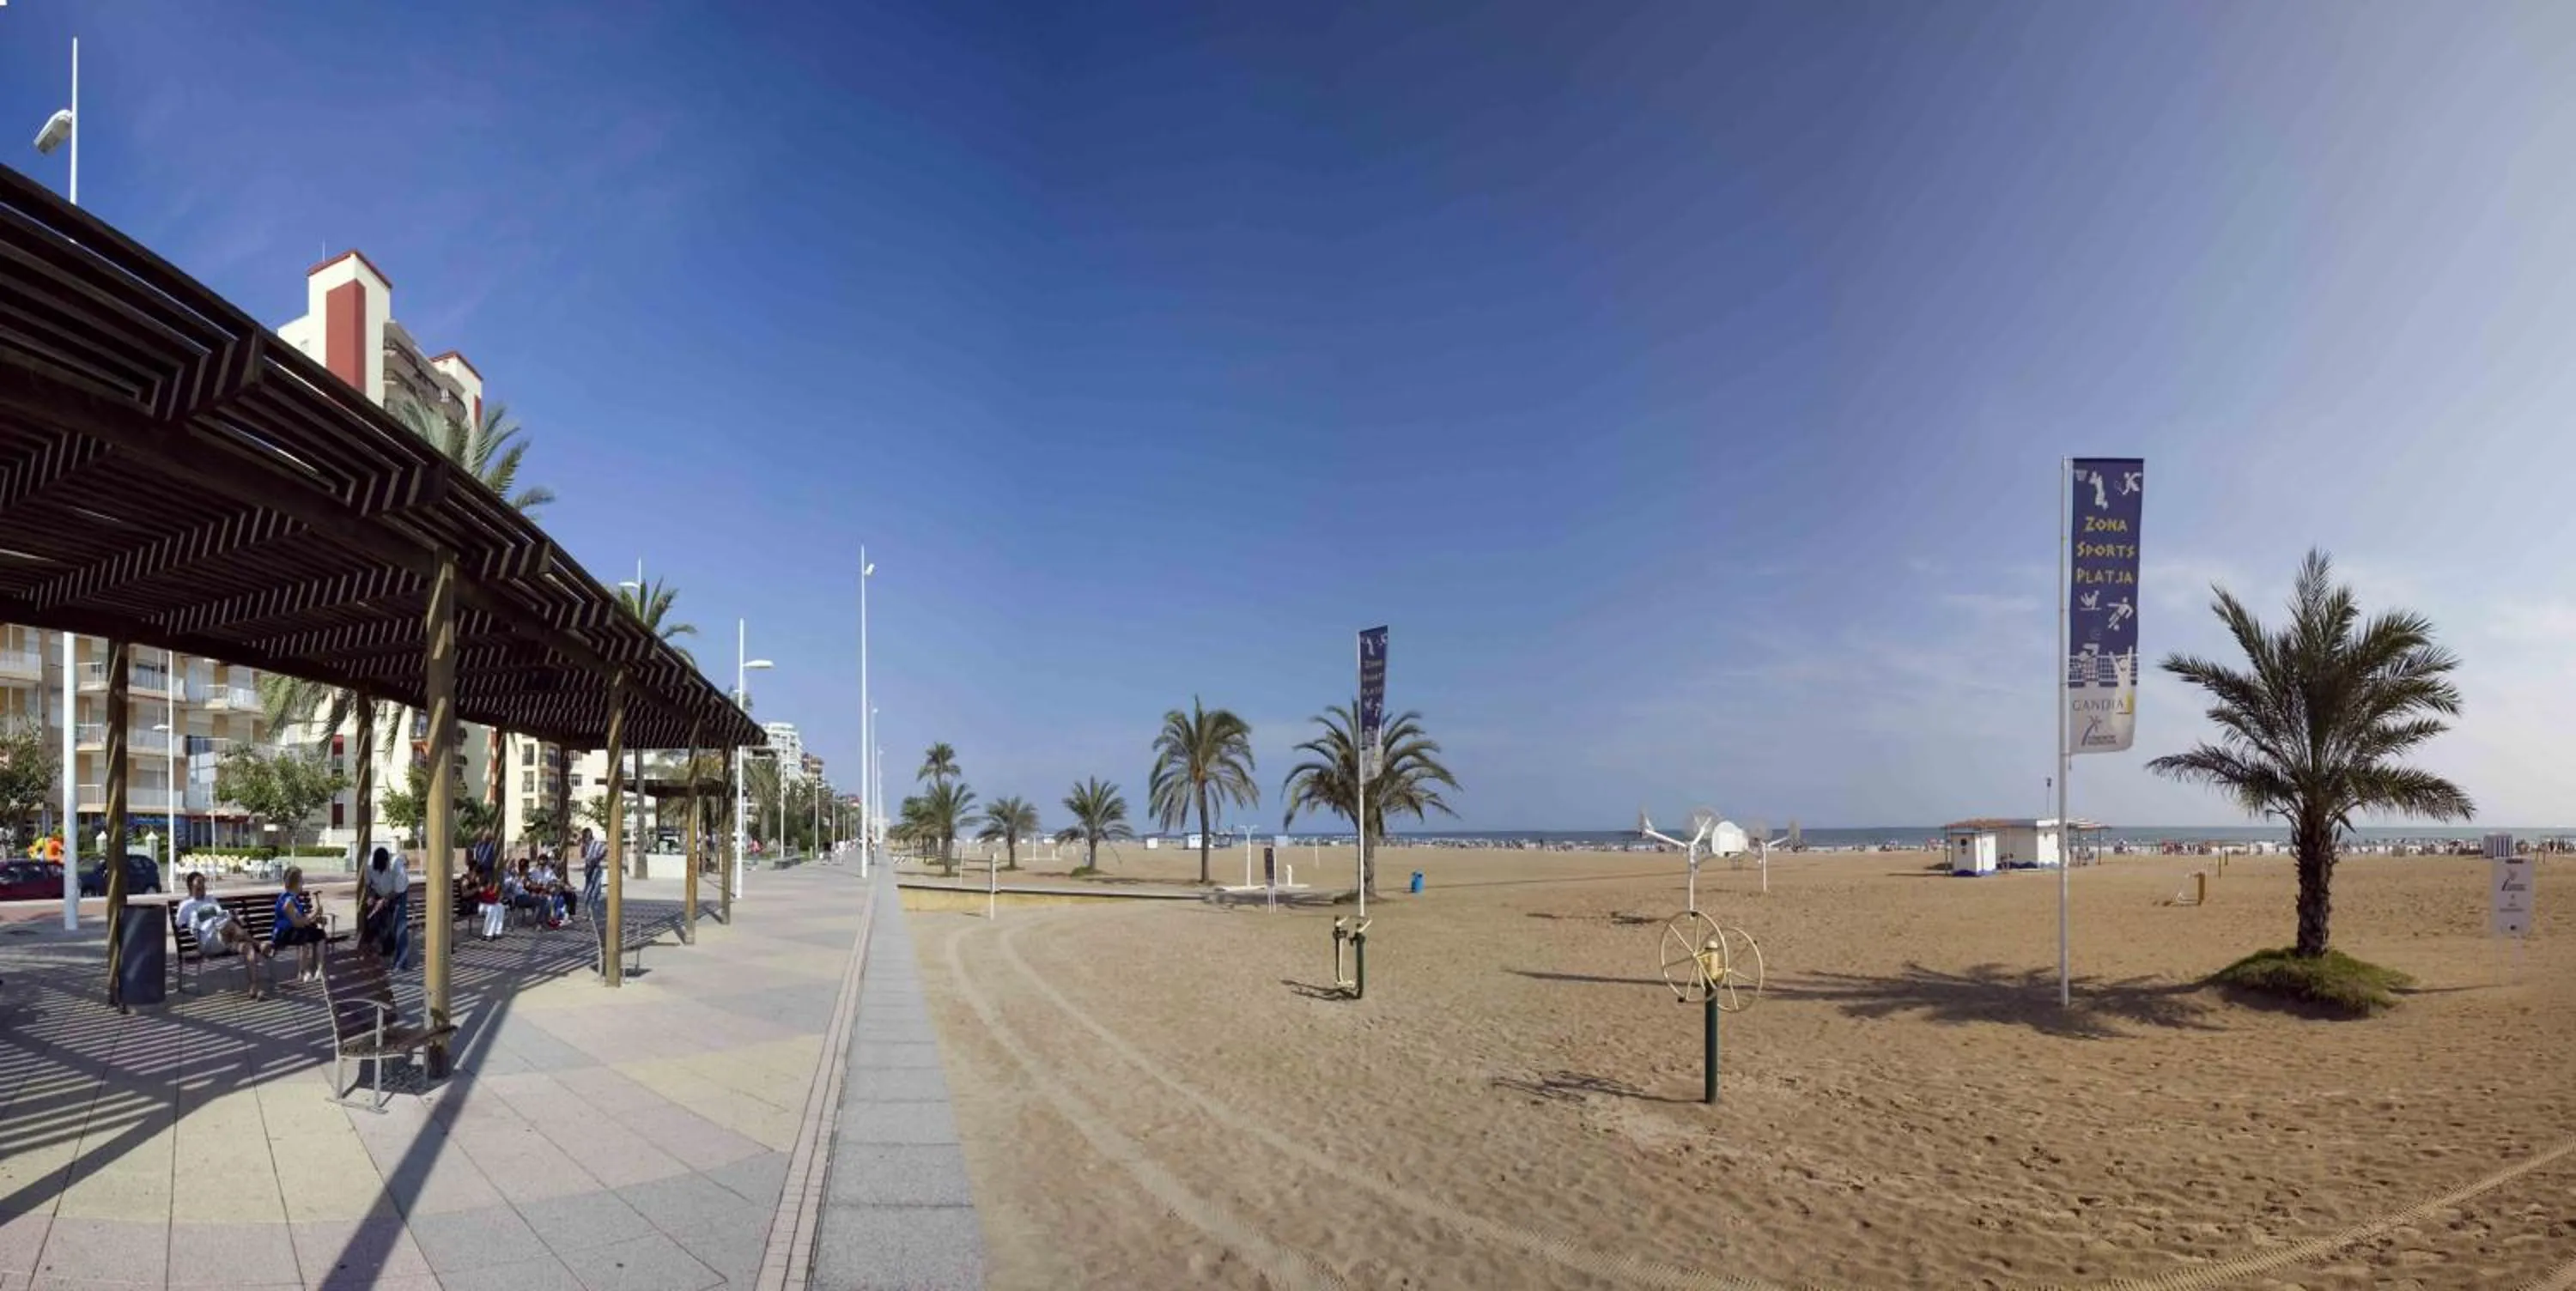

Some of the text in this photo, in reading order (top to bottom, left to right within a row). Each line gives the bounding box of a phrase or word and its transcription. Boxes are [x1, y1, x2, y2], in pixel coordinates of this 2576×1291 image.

[2084, 516, 2128, 533] ZONA
[2076, 542, 2136, 559] SPORTS
[2076, 567, 2134, 585] PLATJA
